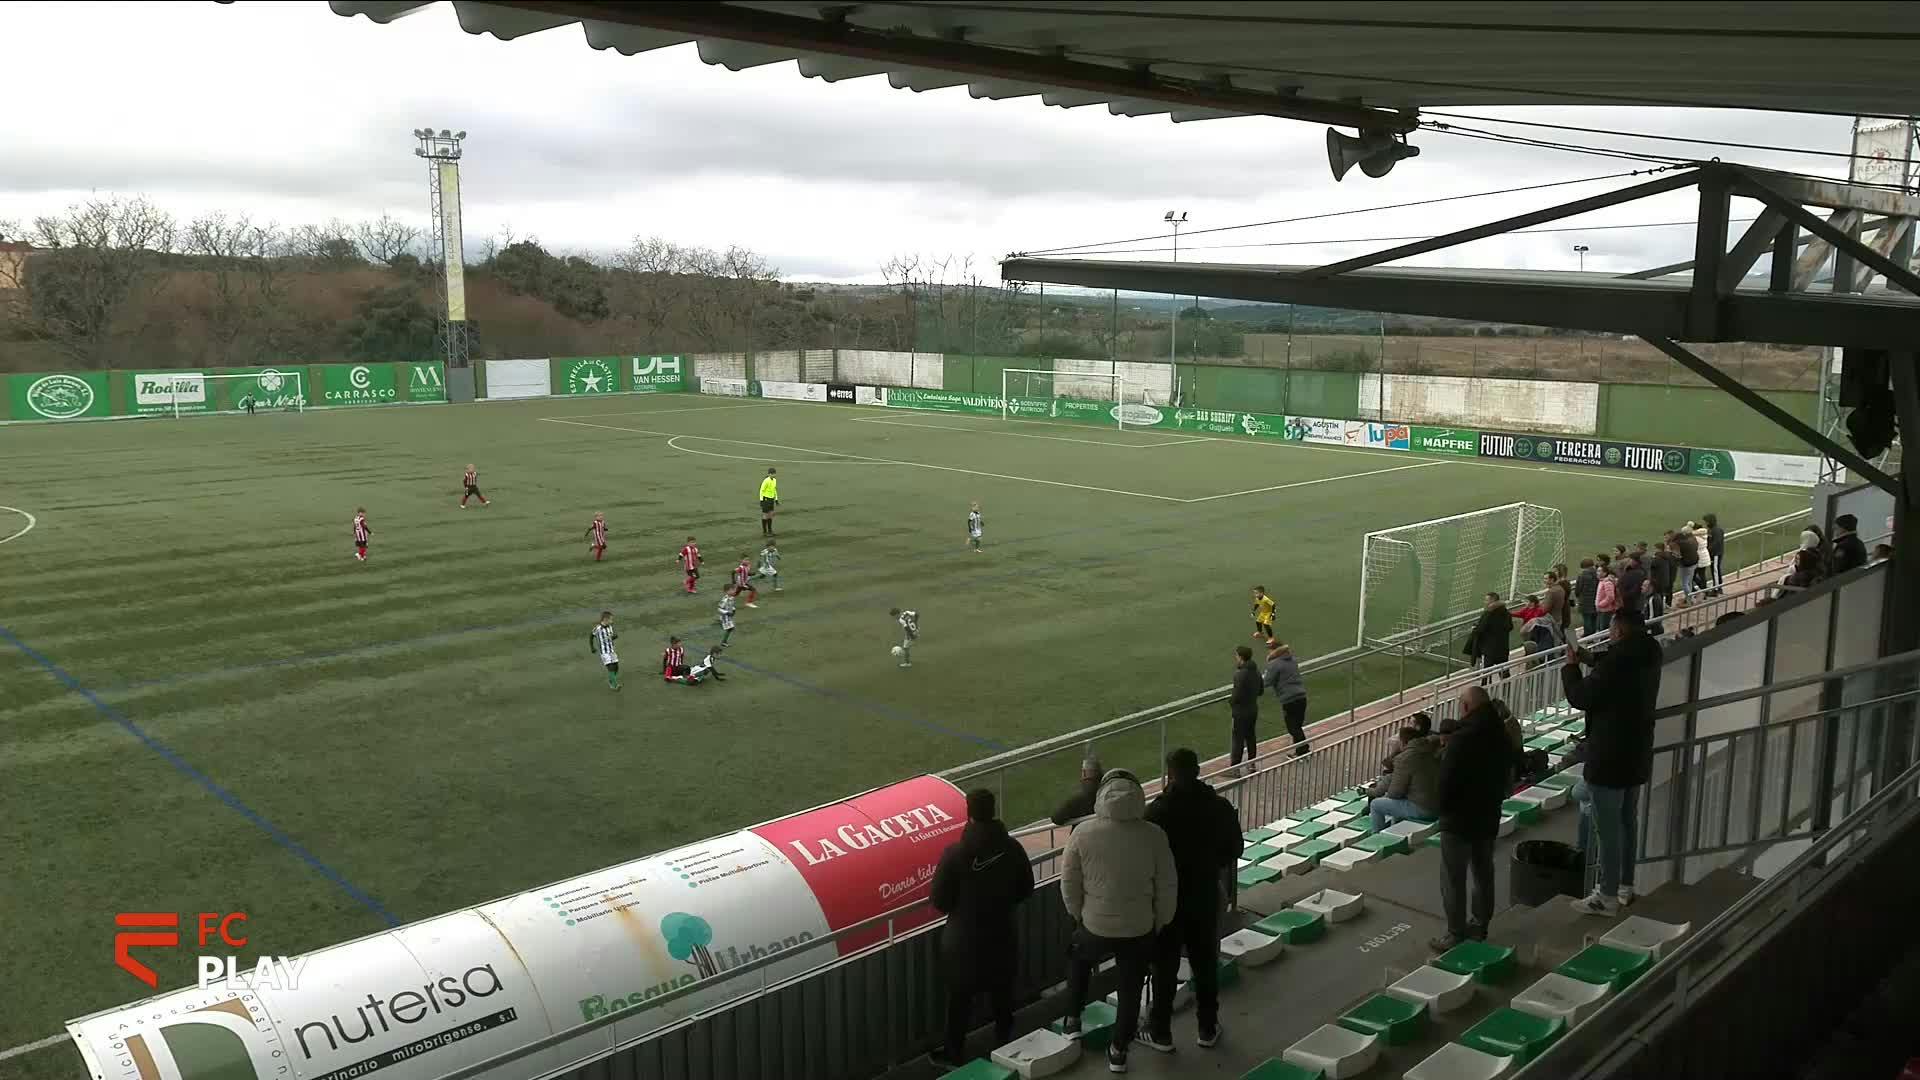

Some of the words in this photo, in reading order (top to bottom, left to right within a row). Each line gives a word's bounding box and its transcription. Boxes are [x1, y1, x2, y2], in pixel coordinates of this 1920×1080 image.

[634, 376, 650, 384] VAN
[651, 375, 680, 383] HESSEN
[325, 388, 396, 400] CARRASCO
[1064, 402, 1099, 410] PROPERTIES
[1368, 424, 1408, 447] lupa
[1423, 437, 1473, 450] MAPFRE
[1555, 440, 1601, 459] TERCERA
[1554, 456, 1601, 465] FEDERACIÓN
[790, 838, 848, 866] LA
[836, 803, 953, 850] GACETA
[690, 865, 719, 876] Piscinas
[698, 875, 720, 885] Pistas
[879, 876, 916, 898] Diario
[560, 889, 609, 905] Instalaciones
[568, 902, 599, 914] Parques
[576, 909, 613, 923] Mobiliario
[613, 900, 640, 913] Urbano
[294, 964, 504, 1059] nutersa
